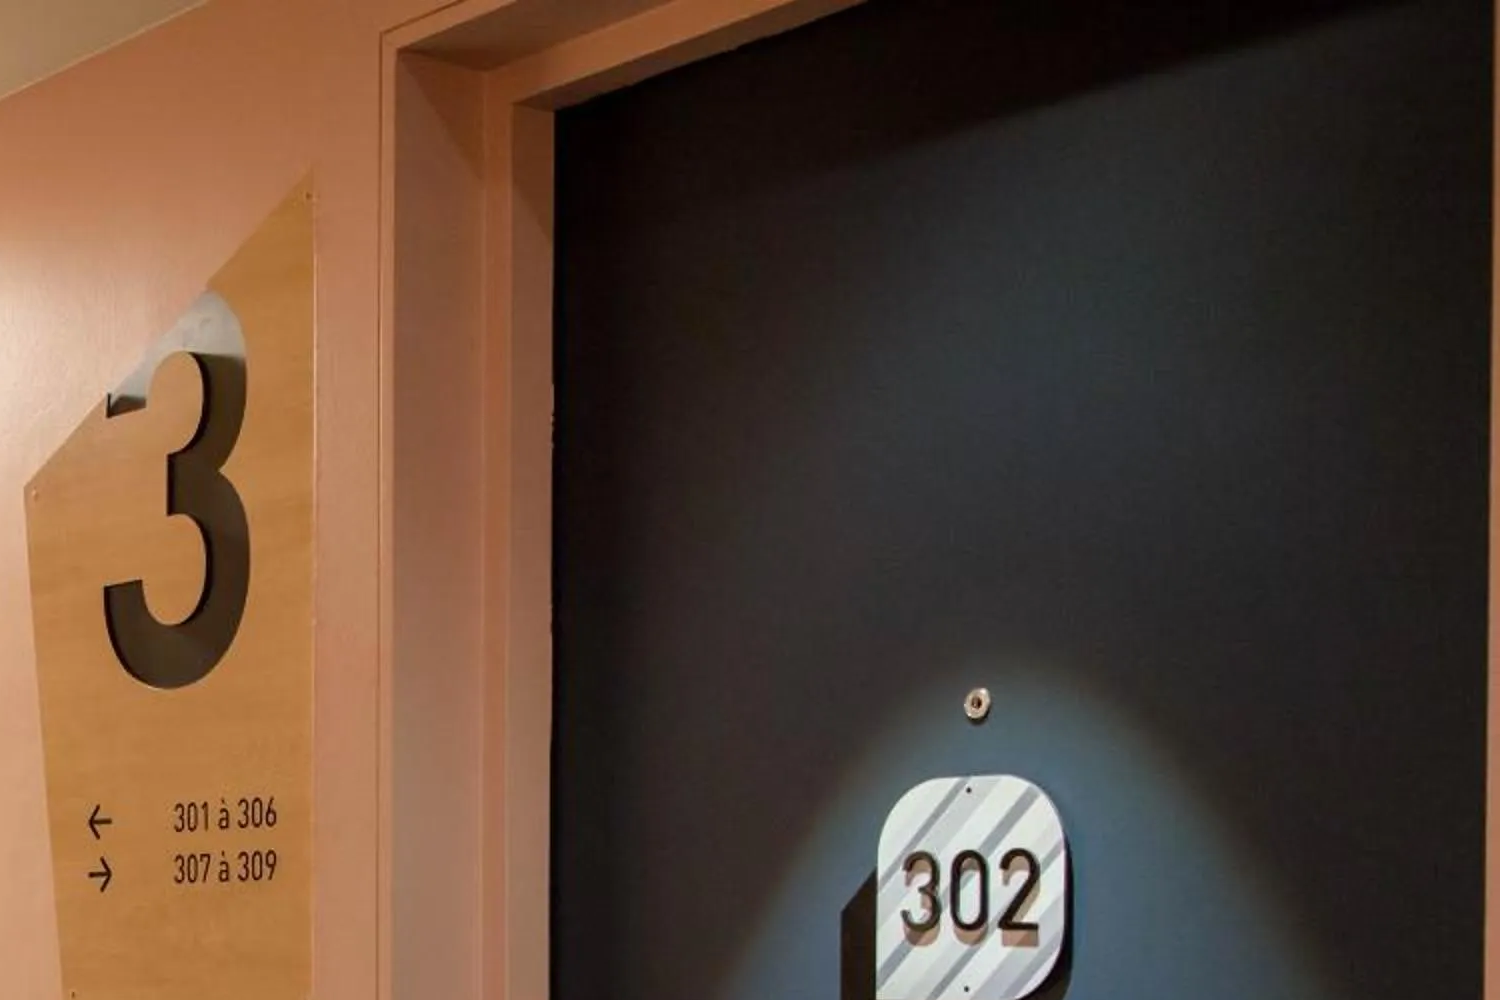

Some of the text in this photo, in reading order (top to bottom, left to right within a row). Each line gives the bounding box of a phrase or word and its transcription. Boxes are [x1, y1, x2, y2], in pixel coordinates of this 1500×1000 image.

[103, 287, 250, 690] 3
[174, 796, 278, 832] 301 à 306
[174, 849, 278, 884] 307 à 309
[901, 847, 1040, 932] 302
